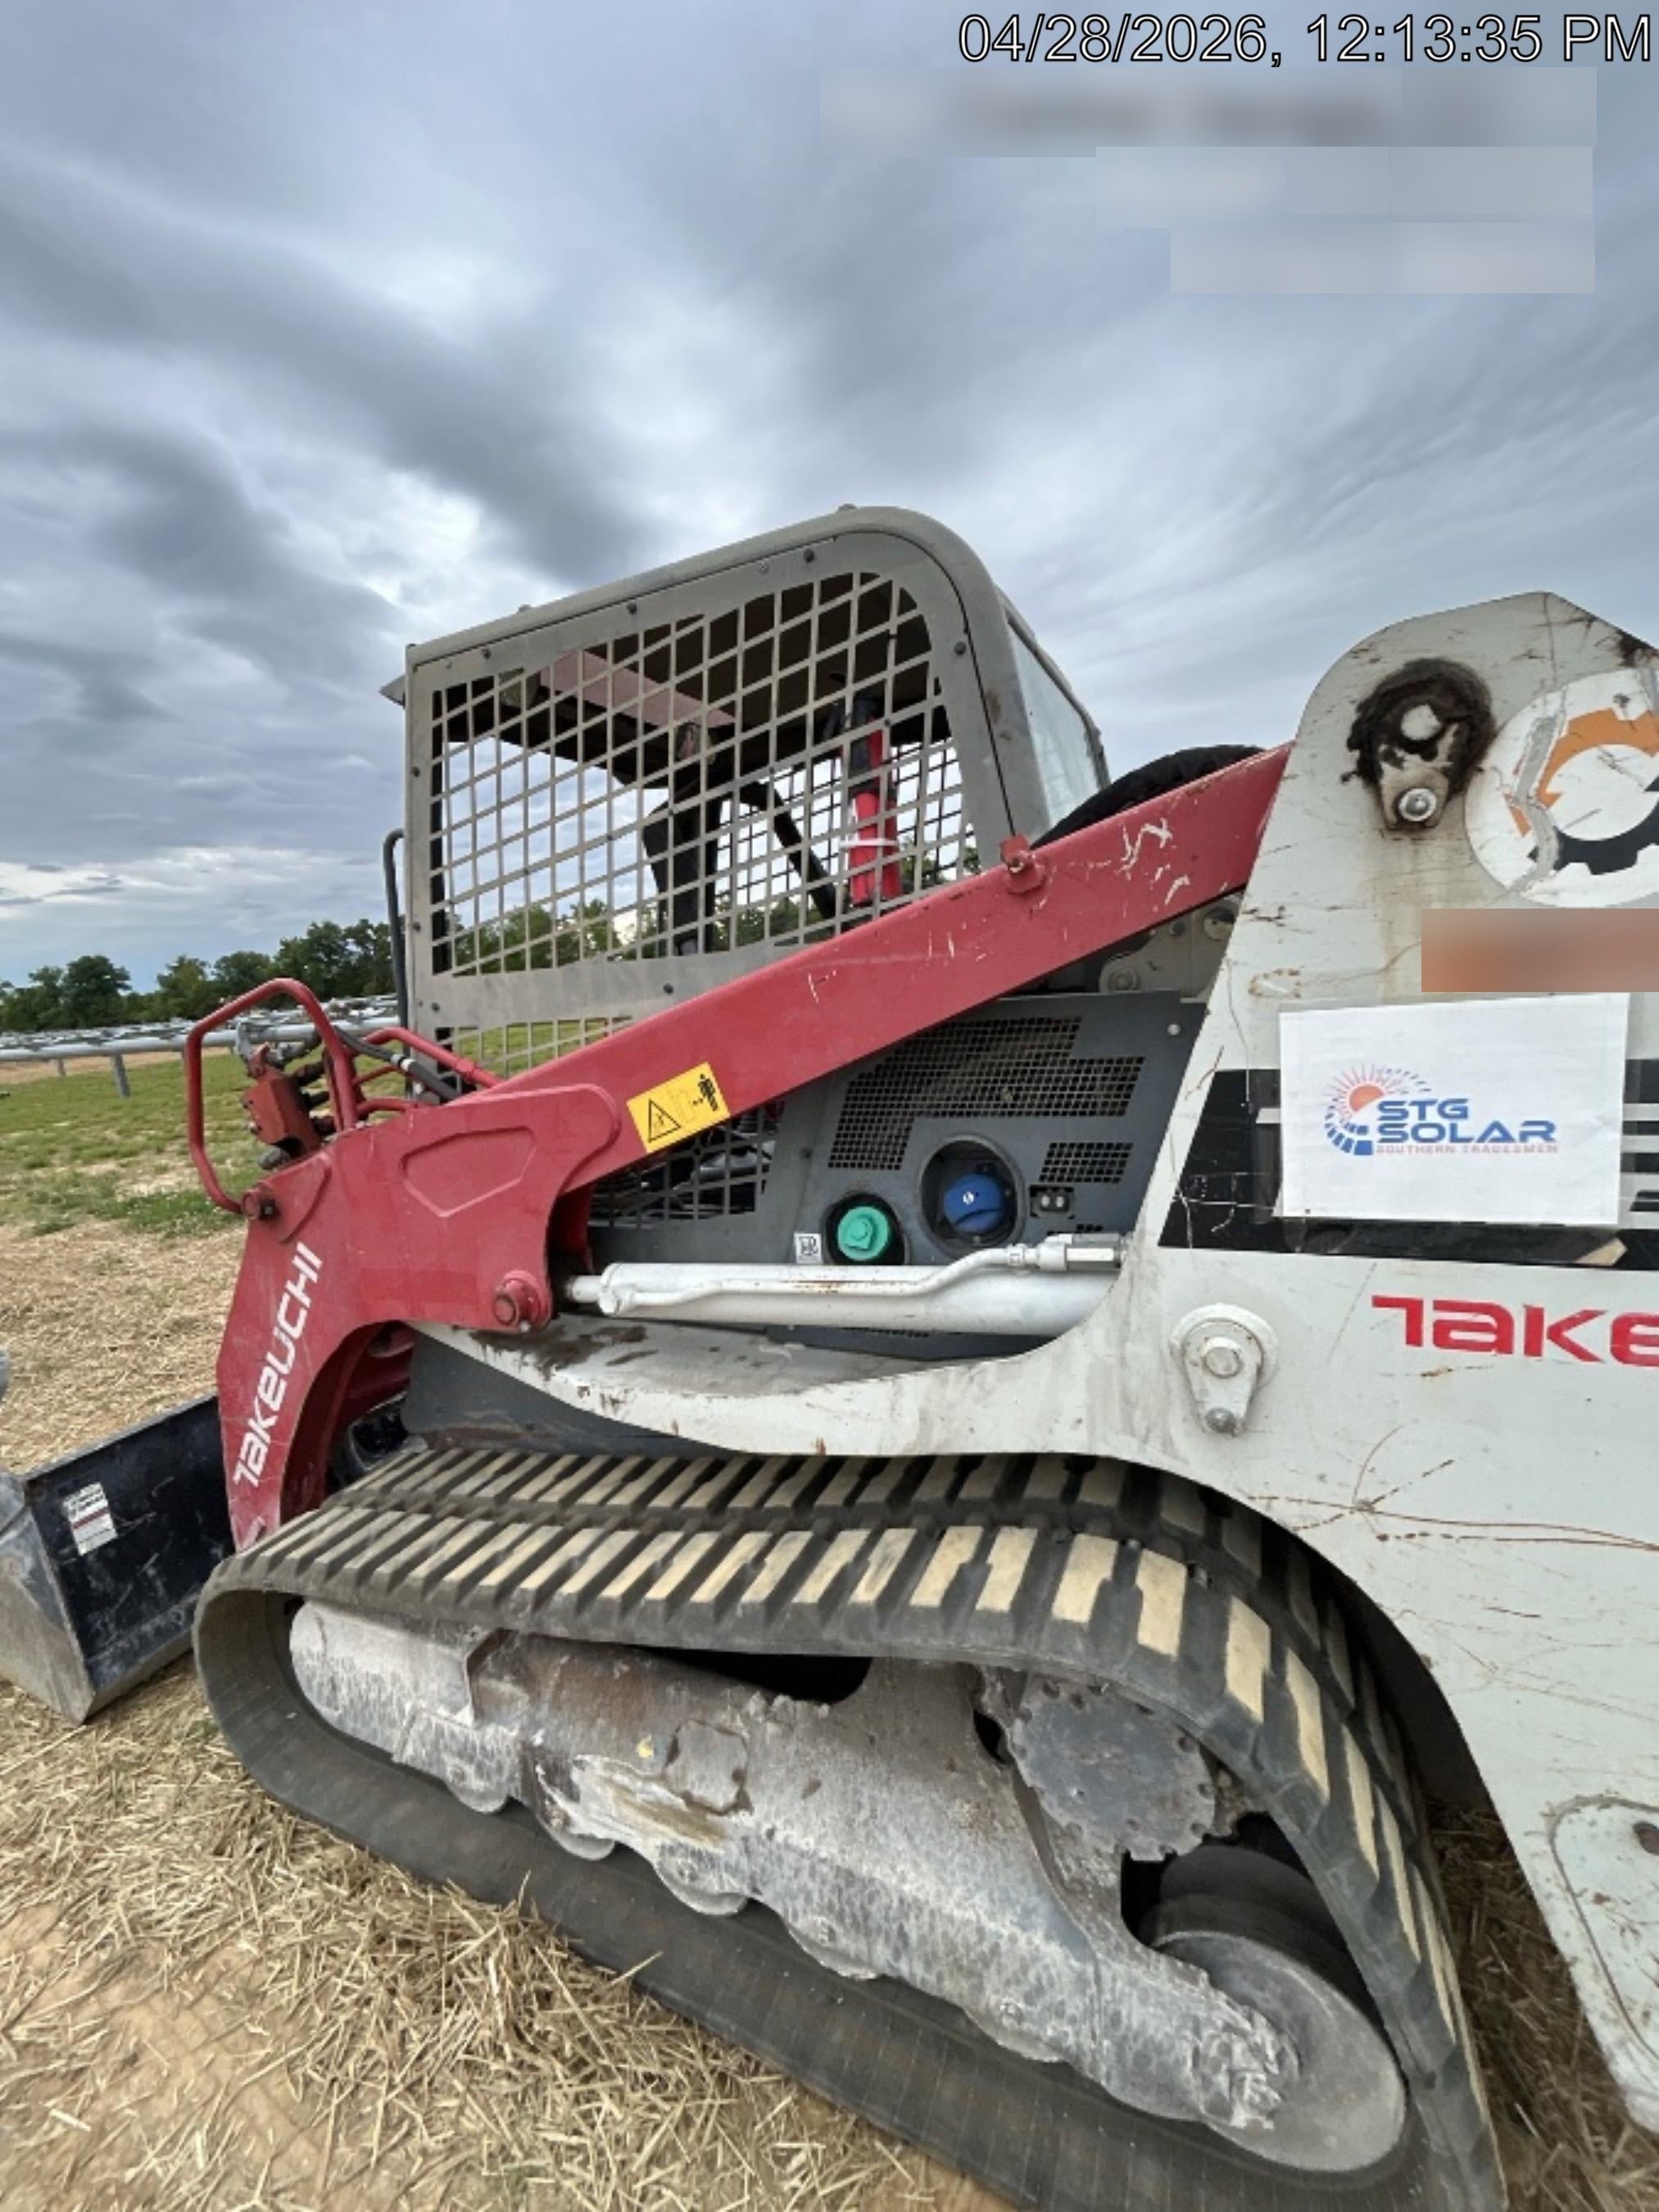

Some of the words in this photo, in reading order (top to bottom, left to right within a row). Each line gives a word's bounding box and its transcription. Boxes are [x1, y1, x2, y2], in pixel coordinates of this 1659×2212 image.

[1378, 1098, 1469, 1122] STG
[1377, 1120, 1557, 1144] SOLAR
[1376, 1145, 1456, 1154] SOUTHERN
